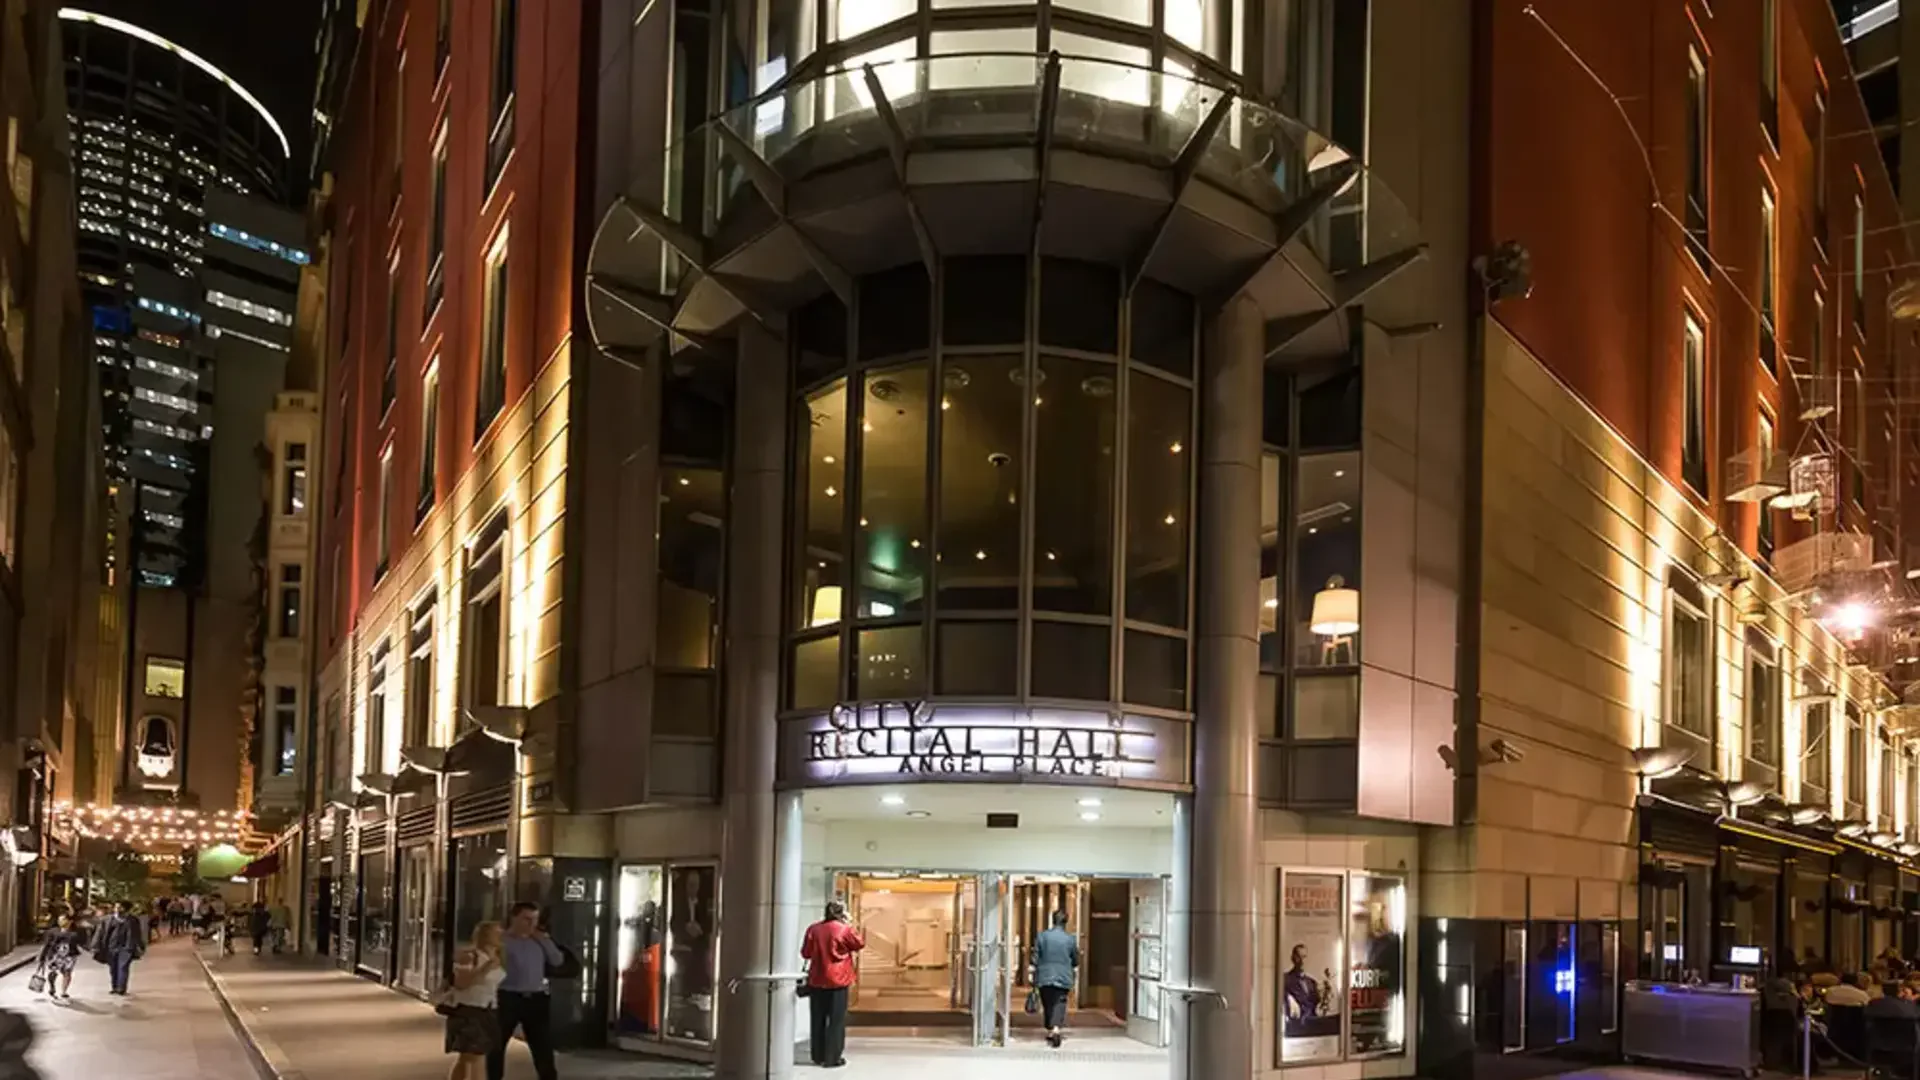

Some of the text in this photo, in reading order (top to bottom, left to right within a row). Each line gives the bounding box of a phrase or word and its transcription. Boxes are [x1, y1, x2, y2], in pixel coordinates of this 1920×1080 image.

[829, 701, 924, 732] CITY
[810, 727, 1128, 761] RECITAL HALL
[899, 756, 1103, 776] ANGEL PLACE
